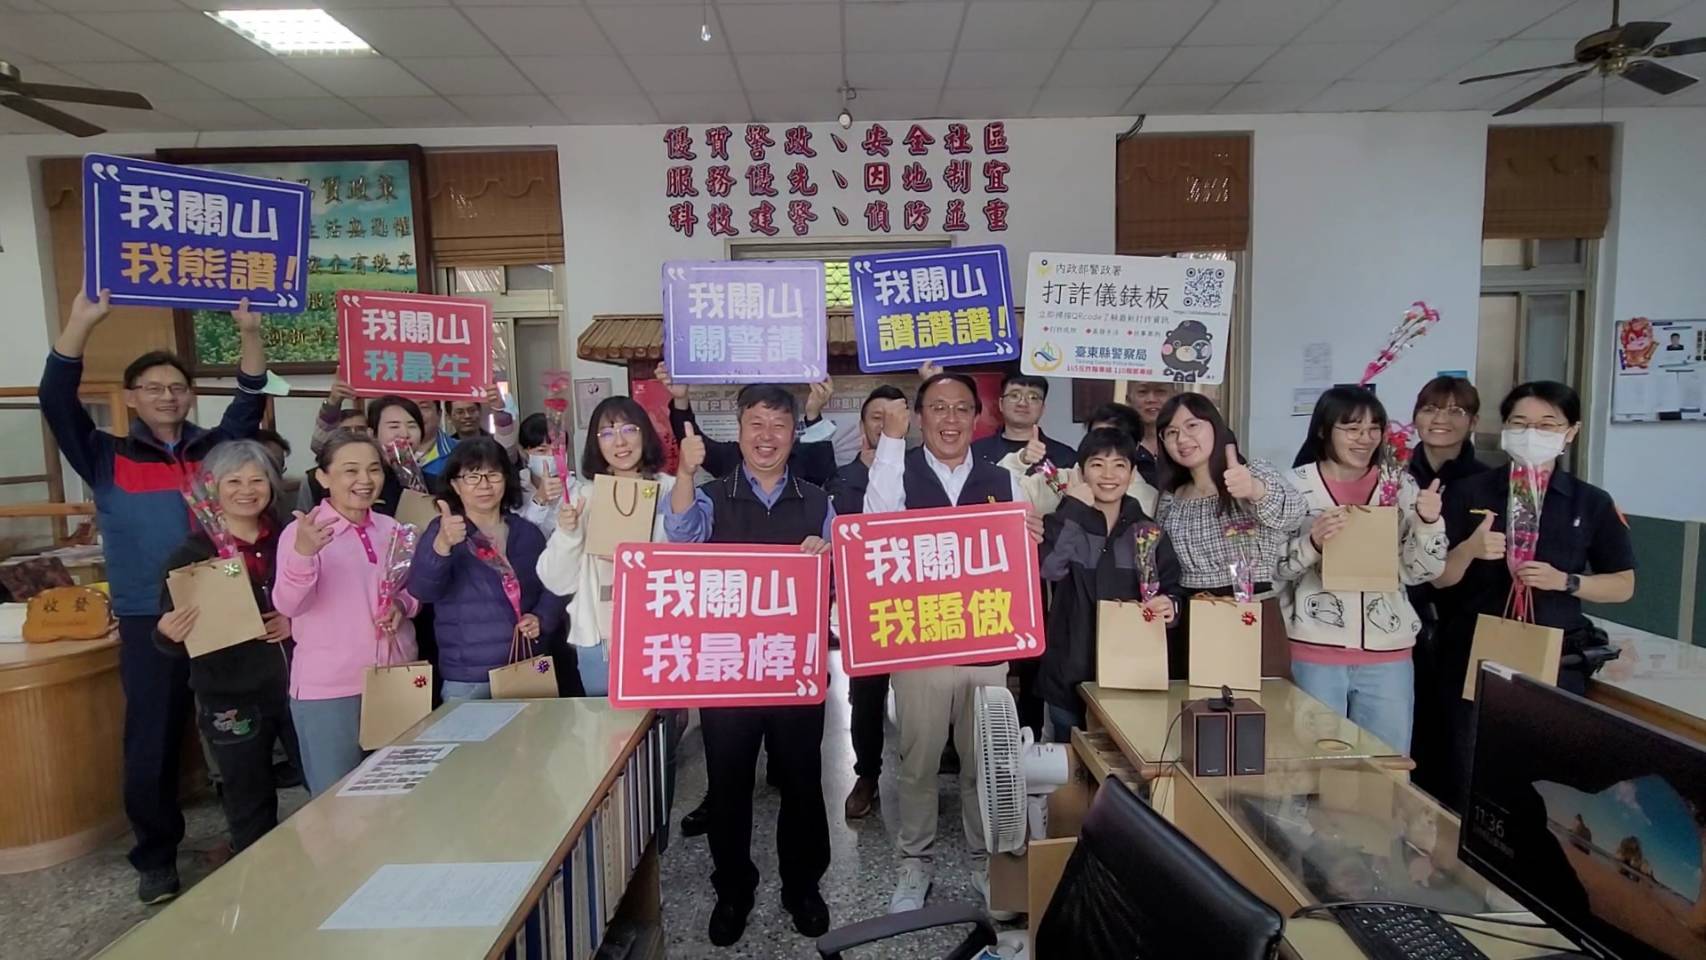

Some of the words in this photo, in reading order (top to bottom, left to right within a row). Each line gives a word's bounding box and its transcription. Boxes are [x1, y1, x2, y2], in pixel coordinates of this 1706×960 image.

[663, 122, 1010, 161] 優質警政、安全社區
[297, 175, 398, 204] 質政策
[666, 160, 1010, 197] 服務優先、因地制宜
[119, 183, 279, 241] 我關山
[120, 241, 298, 292] 我熊讚!
[874, 263, 987, 306] 我關山
[687, 281, 803, 321] 我關山
[1042, 280, 1170, 310] 打詐儀錶板
[362, 307, 471, 346] 我關山
[688, 323, 804, 364] 關警讚
[877, 304, 1009, 352] 讚讚讚!
[364, 348, 472, 385] 我最牛
[1075, 346, 1147, 360] 臺東縣警察局
[864, 528, 1009, 587] 我關山
[645, 569, 798, 618] 我關山
[869, 588, 1015, 648] 我驕傲
[642, 632, 818, 684] 我最棒!
